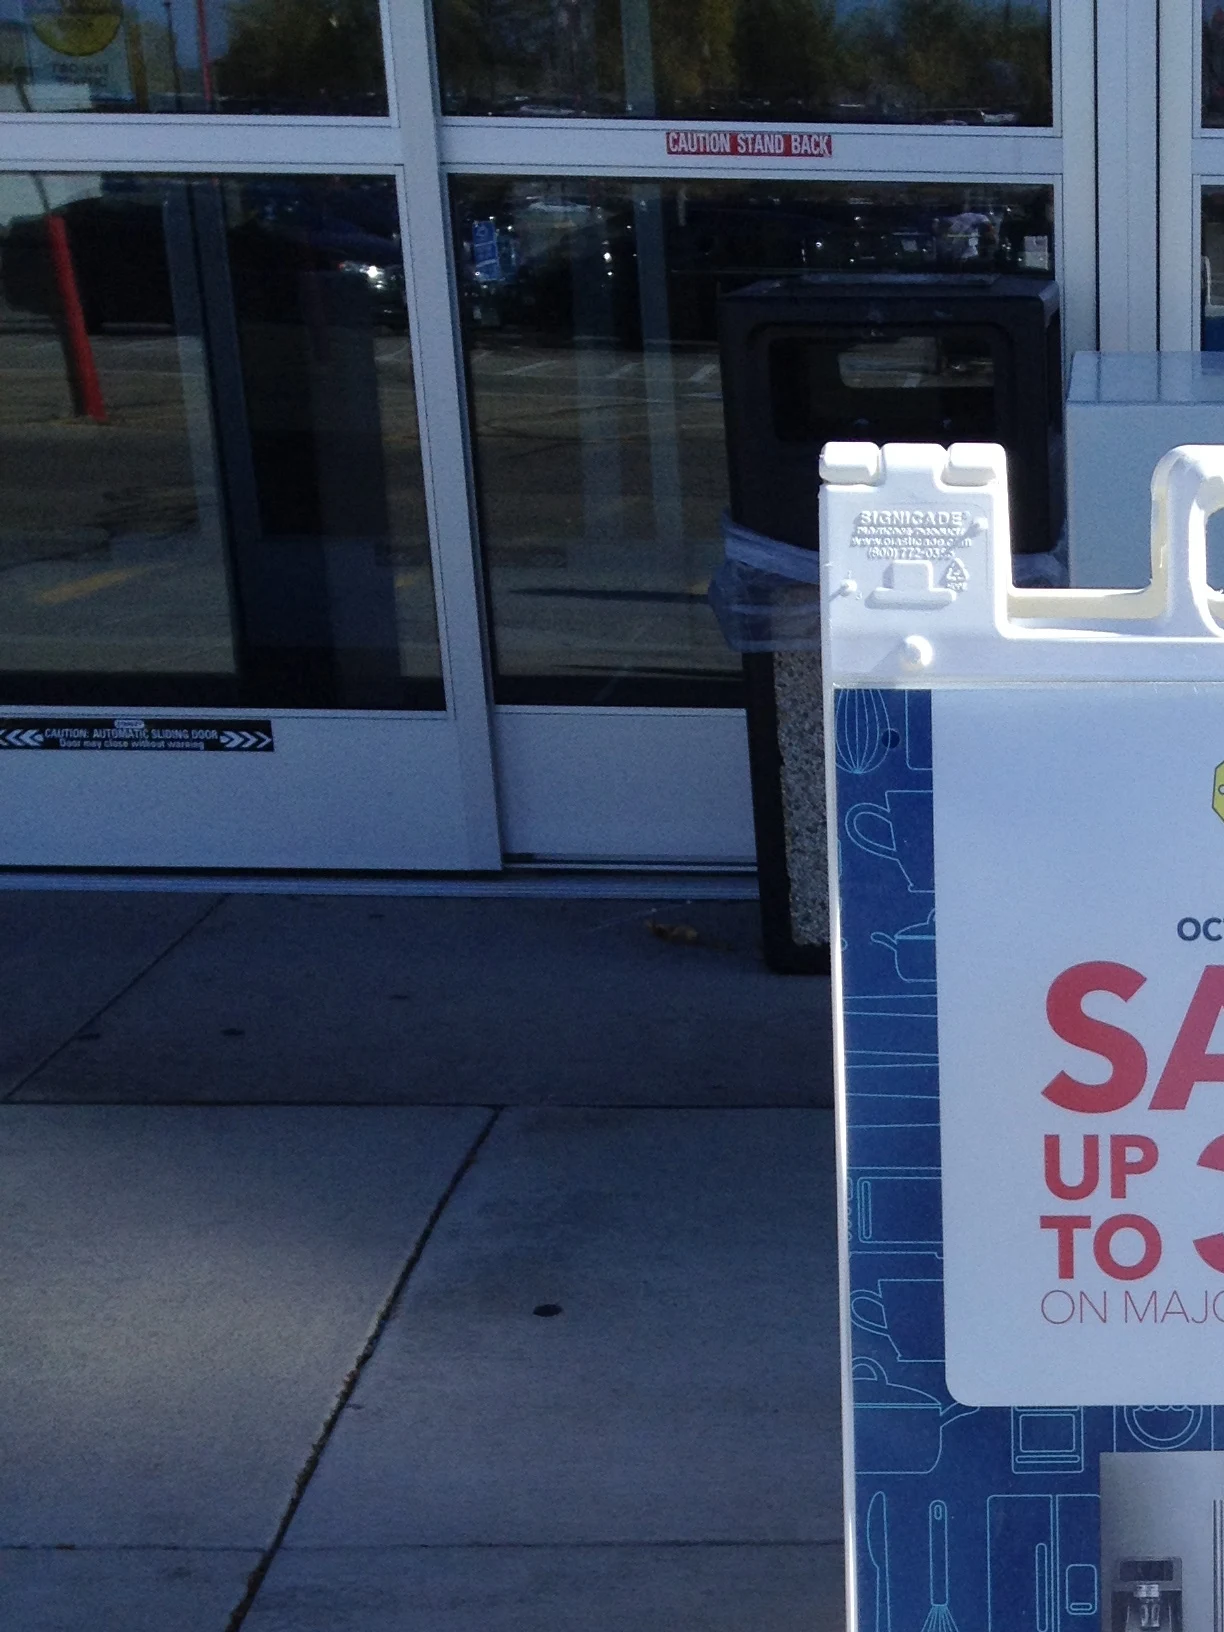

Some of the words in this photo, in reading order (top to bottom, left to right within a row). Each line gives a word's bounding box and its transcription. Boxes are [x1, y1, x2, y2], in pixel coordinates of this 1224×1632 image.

[668, 131, 730, 153] CAUTION
[737, 133, 785, 154] STAND
[791, 134, 829, 155] BACK
[859, 510, 964, 526] SIGNICADE
[1043, 1134, 1159, 1201] UP
[1039, 1213, 1163, 1281] TO
[1040, 1289, 1108, 1325] ON
